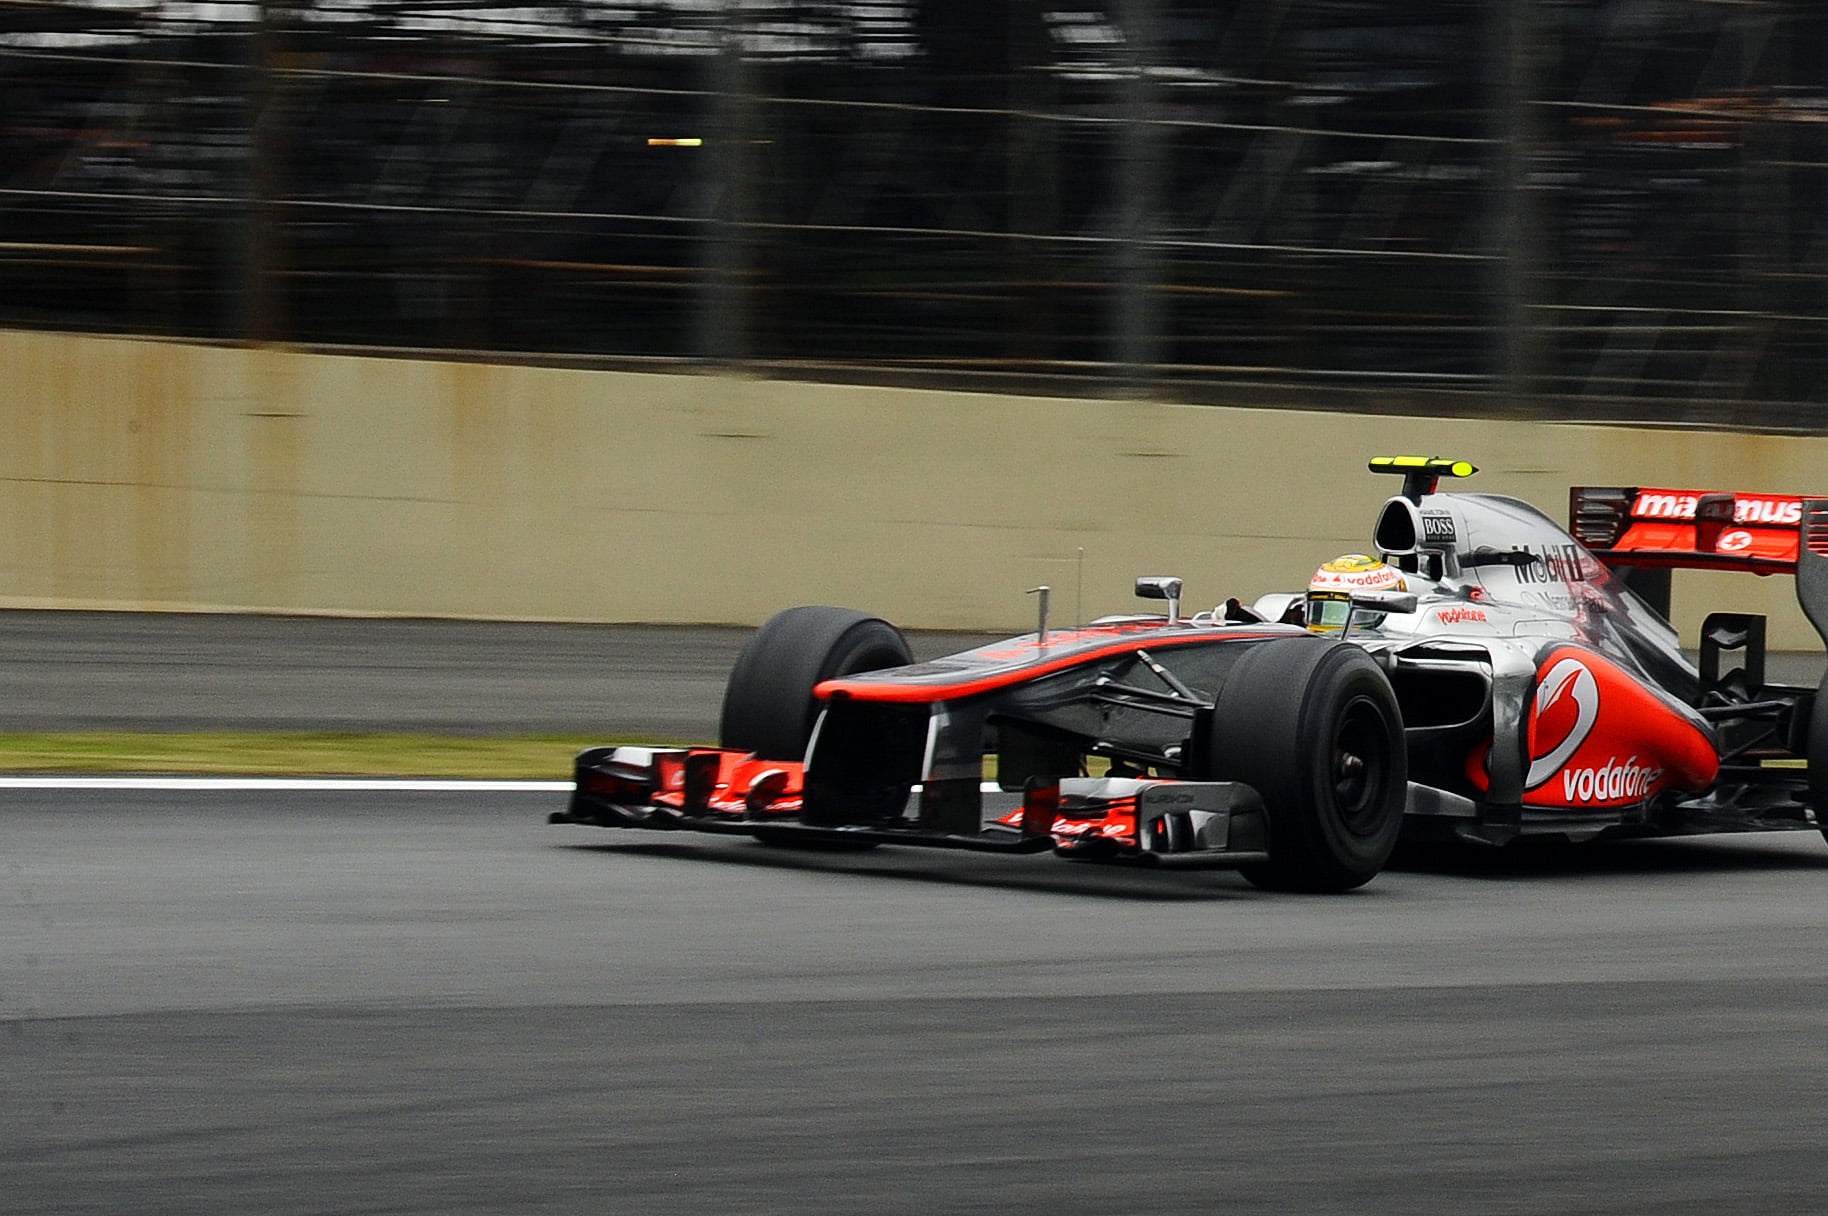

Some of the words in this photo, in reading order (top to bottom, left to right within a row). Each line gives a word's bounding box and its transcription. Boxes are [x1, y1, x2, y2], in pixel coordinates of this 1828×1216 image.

[1424, 518, 1454, 535] BOSS
[1512, 544, 1567, 583] Mobil
[1563, 755, 1664, 802] vodafone
